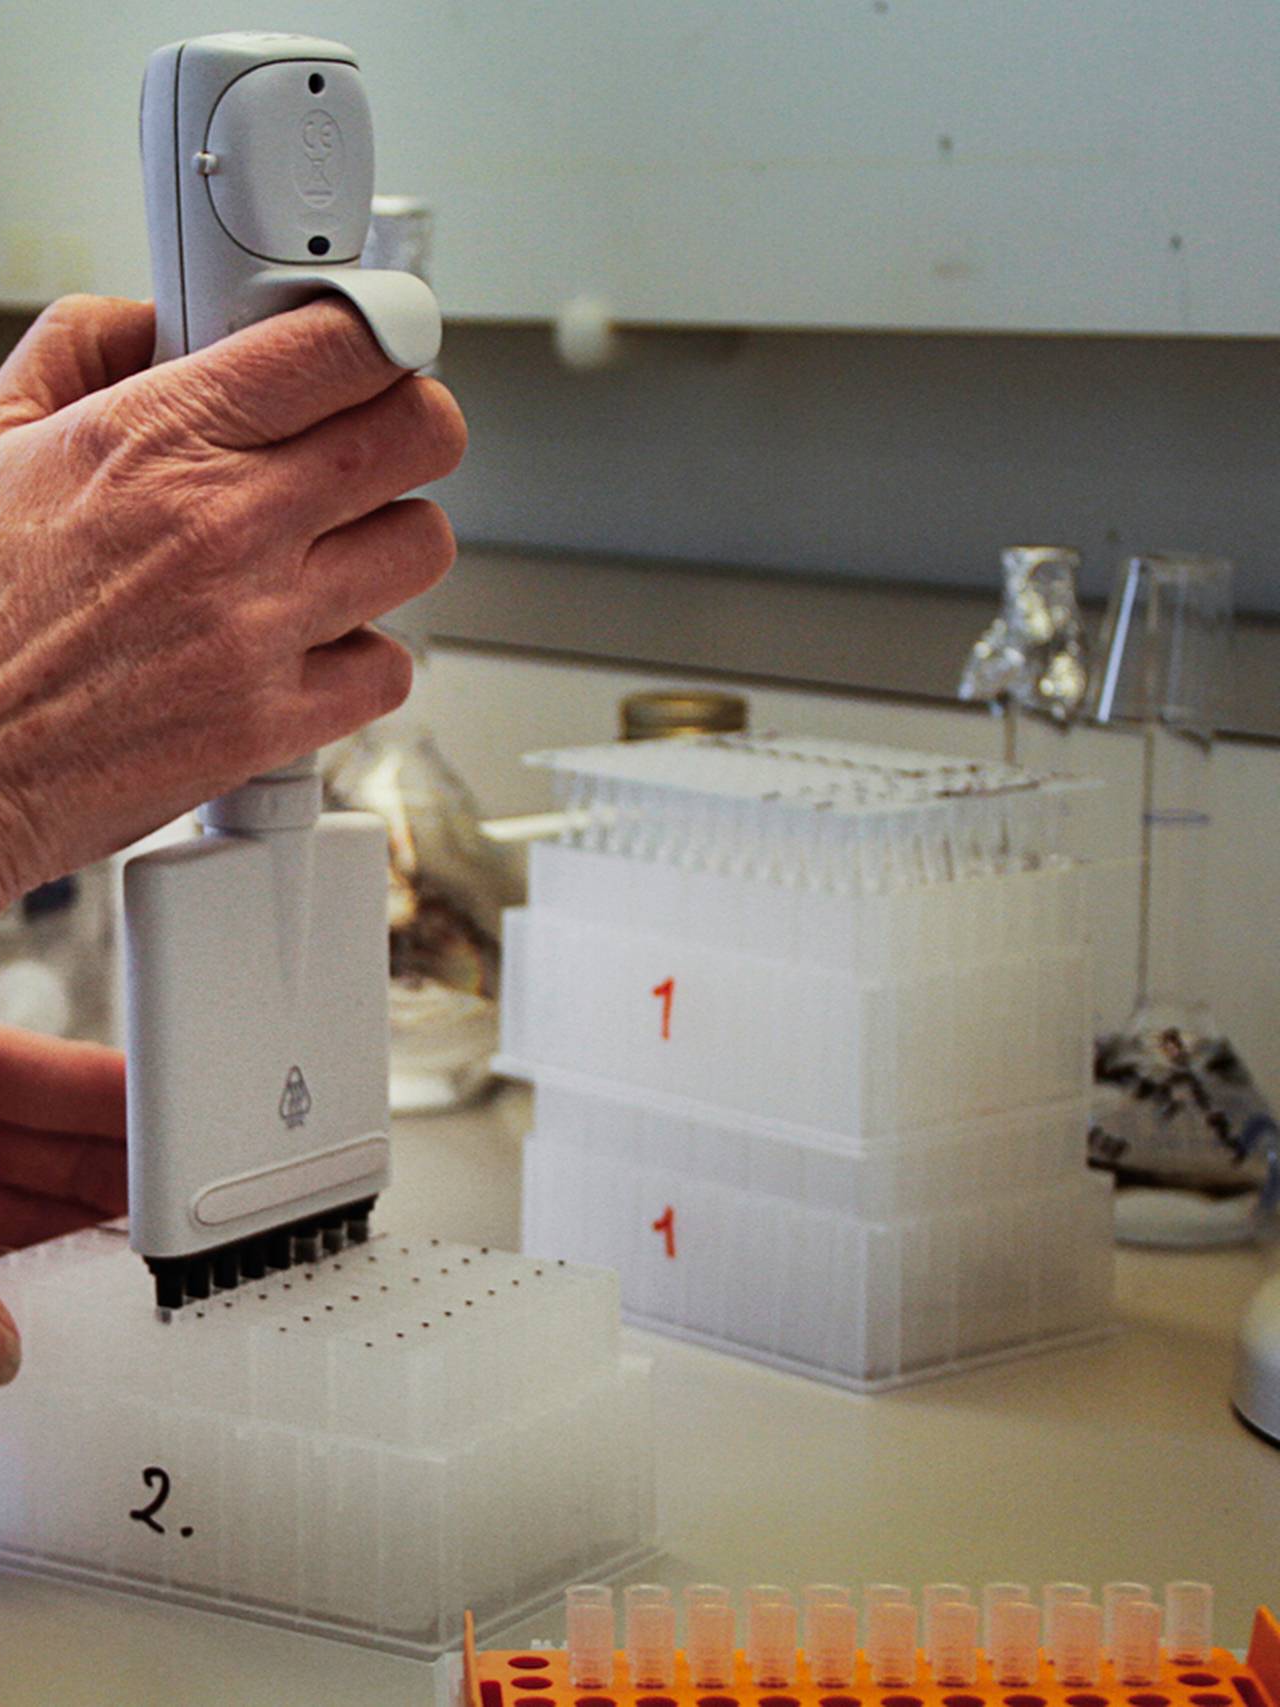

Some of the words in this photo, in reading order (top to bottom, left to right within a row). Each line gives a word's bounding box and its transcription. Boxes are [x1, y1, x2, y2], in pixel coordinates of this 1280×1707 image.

[651, 976, 674, 1041] 1
[652, 1205, 676, 1260] 1
[129, 1466, 194, 1538] 2.
